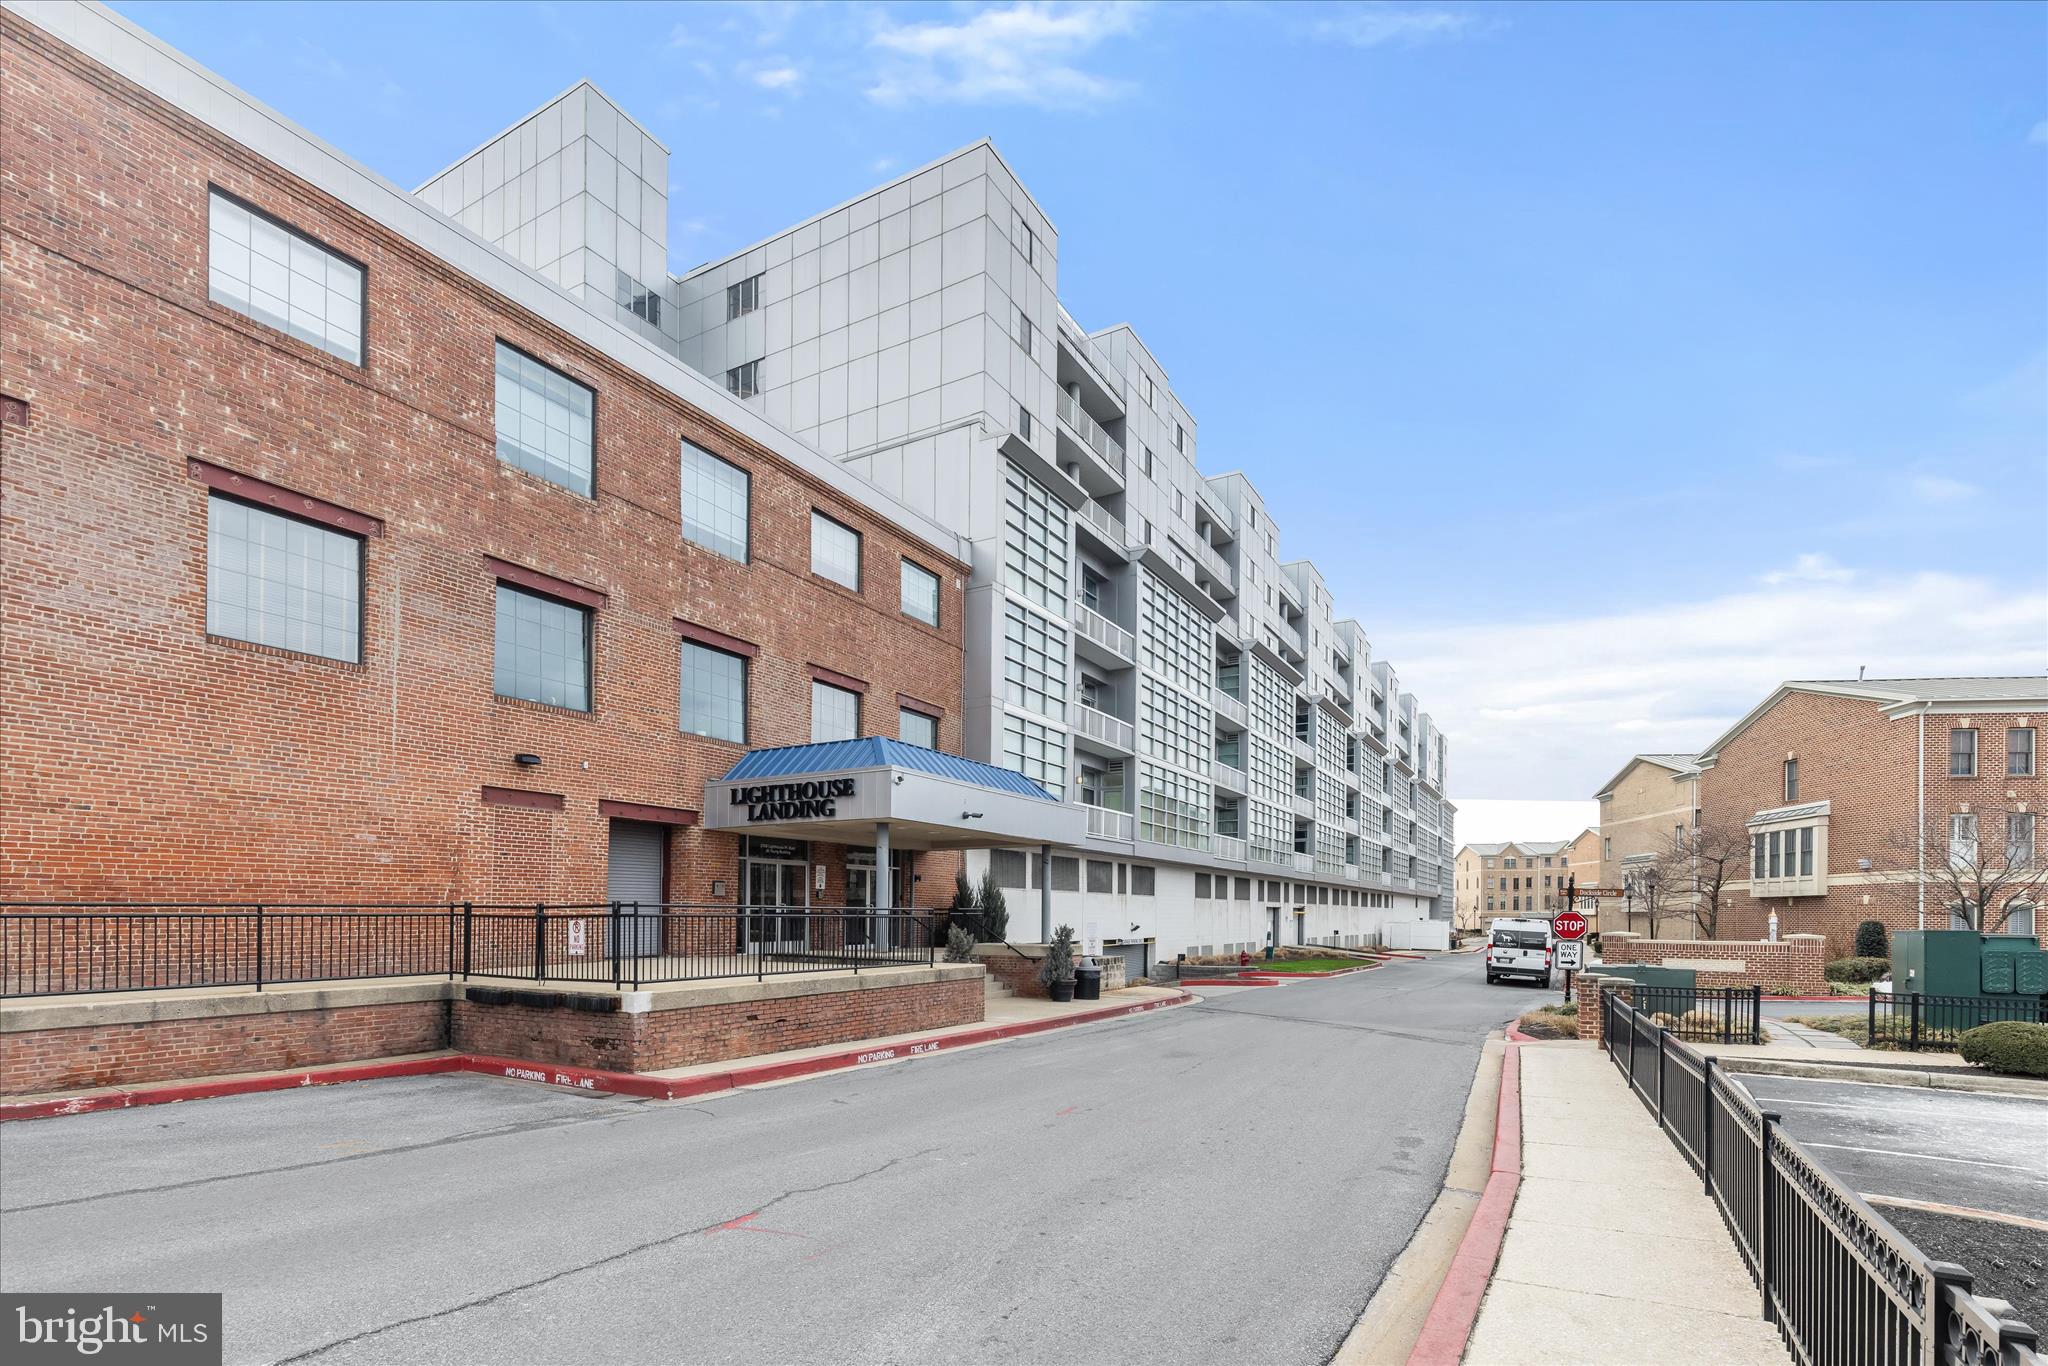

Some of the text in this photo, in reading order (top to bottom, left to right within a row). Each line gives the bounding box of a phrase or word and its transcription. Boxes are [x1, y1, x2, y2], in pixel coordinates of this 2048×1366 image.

[730, 778, 855, 805] LIGHTHOUSE
[747, 799, 836, 821] LANDING
[1580, 889, 1601, 897] Dockside
[1555, 920, 1585, 931] STOP
[857, 1041, 939, 1063] NO PARKING FIRE LANE
[505, 1067, 516, 1077] NO
[516, 1067, 546, 1082] PARKING
[555, 1073, 573, 1086] FIRE
